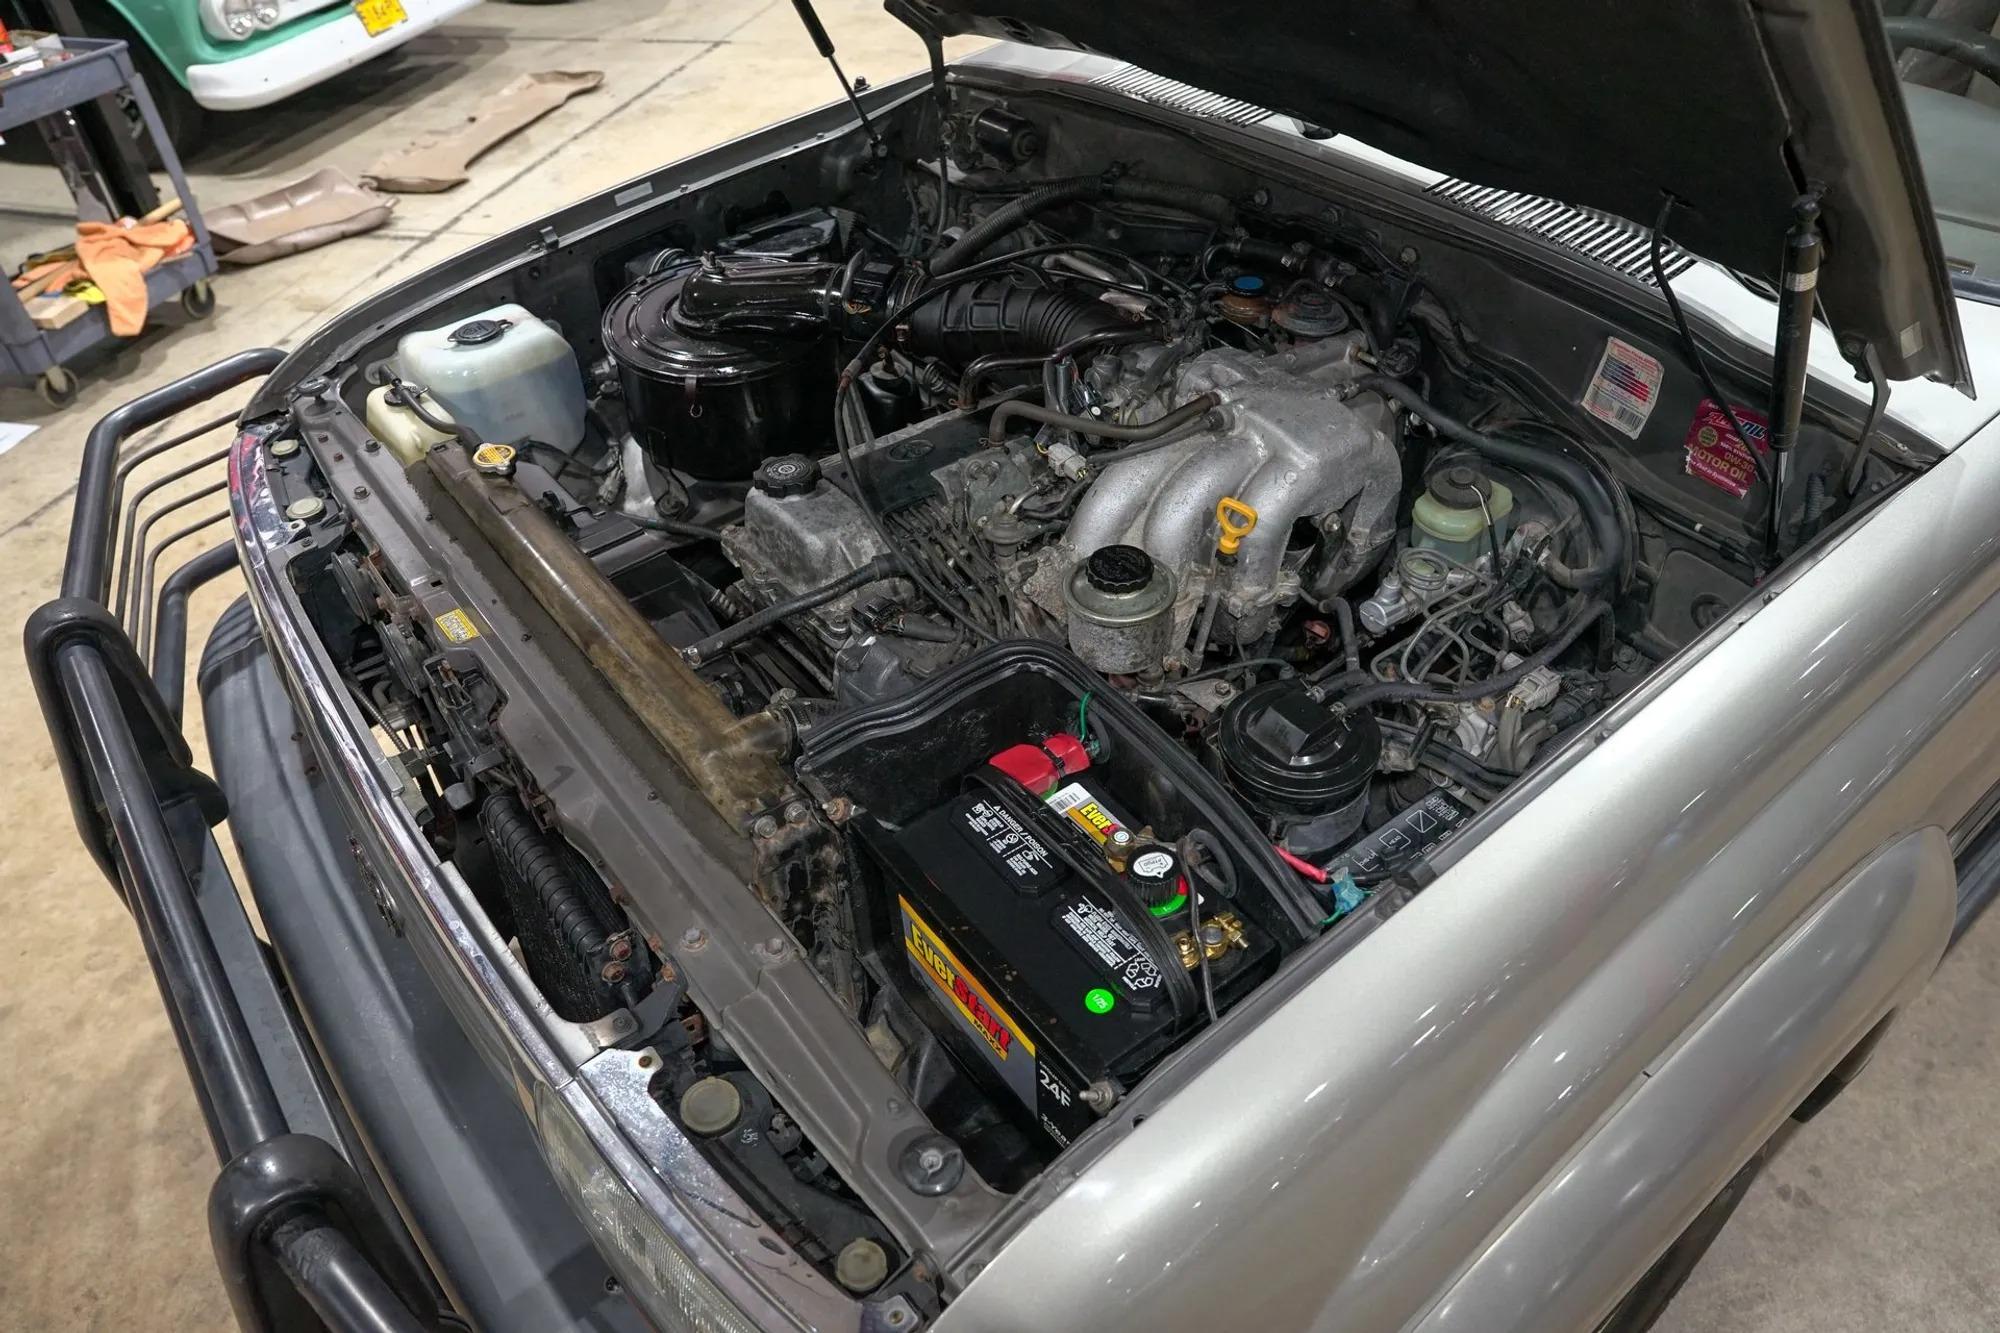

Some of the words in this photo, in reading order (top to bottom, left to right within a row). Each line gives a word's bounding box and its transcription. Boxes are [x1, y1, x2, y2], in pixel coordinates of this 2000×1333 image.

[1730, 466, 1748, 483] OIL
[999, 809, 1024, 833] DANGER
[1024, 835, 1049, 857] POISON
[1079, 802, 1120, 837] EverS
[1039, 1069, 1071, 1107] 24F
